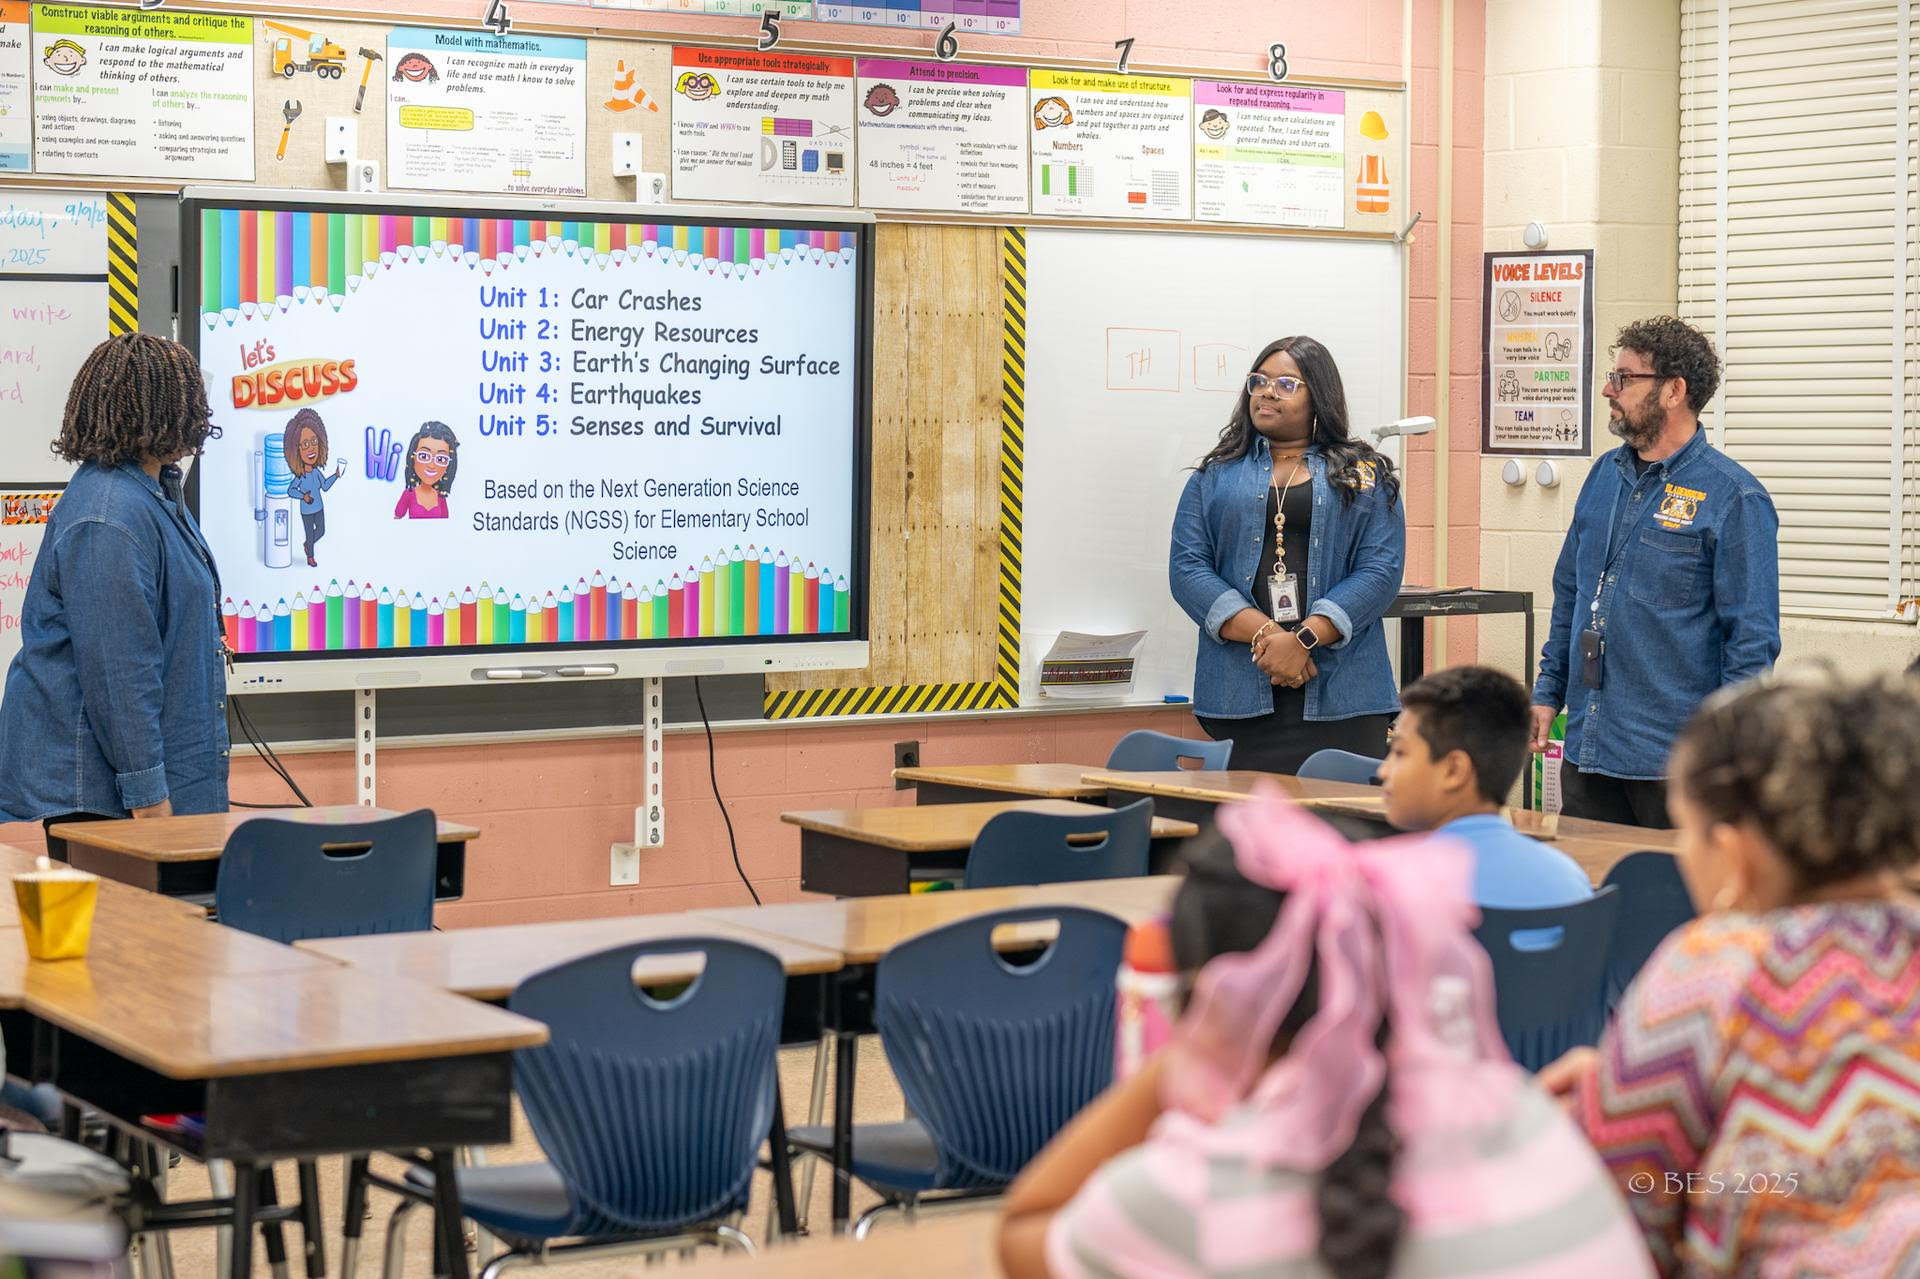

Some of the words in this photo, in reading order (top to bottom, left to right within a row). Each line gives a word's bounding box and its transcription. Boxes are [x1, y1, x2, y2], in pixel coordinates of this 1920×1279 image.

[41, 5, 88, 19] Construct
[91, 10, 118, 21] viable
[121, 14, 171, 24] arguments
[173, 15, 190, 25] and
[193, 16, 228, 28] critique
[231, 18, 245, 28] the
[484, 0, 511, 34] 4
[85, 24, 130, 37] reasoning
[132, 26, 142, 36] of
[144, 27, 176, 38] others.
[758, 10, 781, 49] 5
[435, 34, 462, 46] Model
[464, 36, 483, 47] with
[485, 38, 542, 52] mathematics.
[935, 21, 957, 60] 6
[100, 42, 103, 51] I
[122, 45, 146, 53] make
[148, 45, 178, 57] logical
[180, 49, 225, 58] arguments
[227, 50, 244, 58] and
[1114, 37, 1136, 73] 7
[100, 58, 136, 68] respond
[150, 60, 164, 68] the
[166, 61, 224, 71] mathematical
[446, 56, 450, 64] I
[452, 58, 465, 66] can
[467, 59, 506, 69] recognize
[508, 60, 528, 70] math
[530, 61, 537, 70] in
[540, 64, 574, 75] everyday
[698, 53, 712, 63] Use
[714, 55, 760, 67] appropriate
[763, 58, 781, 68] tools
[783, 58, 831, 72] strategically.
[1268, 43, 1288, 81] 8
[100, 70, 136, 83] thinking
[138, 72, 148, 81] of
[150, 73, 180, 83] others.
[909, 66, 936, 77] Attend
[937, 68, 945, 78] to
[946, 69, 980, 80] precision.
[446, 84, 486, 94] problems.
[760, 77, 785, 86] certain
[787, 79, 805, 88] tools
[807, 80, 815, 88] to
[816, 81, 832, 90] help
[1052, 75, 1069, 84] Look
[1070, 76, 1081, 85] for
[1083, 77, 1096, 86] and
[1098, 78, 1116, 88] make
[1130, 80, 1138, 89] of
[1139, 81, 1172, 91] structure.
[1217, 84, 1232, 93] Look
[1234, 85, 1244, 94] for
[1246, 86, 1258, 95] and
[1259, 89, 1284, 98] express
[1285, 90, 1316, 100] regularity
[1318, 91, 1324, 100] in
[726, 88, 753, 97] explore
[755, 89, 769, 98] and
[771, 90, 797, 100] deepen
[799, 93, 809, 102] my
[811, 93, 830, 101] math
[908, 85, 912, 93] I
[926, 86, 934, 95] be
[936, 88, 960, 97] precise
[962, 89, 980, 97] when
[982, 89, 1006, 100] solving
[726, 101, 780, 113] understanding.
[908, 98, 940, 108] problems
[942, 99, 955, 108] and
[956, 99, 973, 108] clear
[974, 101, 992, 109] when
[1229, 98, 1258, 107] repeated
[1259, 100, 1291, 110] reasoning.
[908, 110, 959, 122] communicating
[961, 113, 971, 122] my
[972, 113, 992, 122] ideas.
[1052, 141, 1083, 151] Numbers
[1142, 145, 1165, 156] Spaces
[870, 160, 879, 168] 48
[880, 160, 905, 169] inches
[919, 162, 933, 171] feet
[1494, 264, 1530, 281] VOICE
[1534, 262, 1583, 280] LEVELS
[480, 286, 527, 308] Unit
[538, 287, 558, 308] 1:
[571, 288, 608, 310] Car
[618, 289, 702, 312] Crashes
[1530, 291, 1562, 302] SILENCE
[13, 303, 72, 326] write
[480, 318, 527, 340] Unit
[537, 319, 558, 340] 2:
[571, 318, 645, 348] Energy
[654, 321, 758, 344] Resources
[240, 338, 276, 370] let's
[482, 350, 528, 372] Unit
[539, 350, 560, 372] 3:
[573, 350, 650, 373] Earth's
[660, 352, 750, 380] Changing
[760, 353, 841, 376] Surface
[1125, 347, 1152, 380] TH
[1216, 354, 1227, 377] H
[232, 358, 358, 409] DISCUSS
[1534, 371, 1570, 382] PARTNER
[479, 382, 526, 404] Unit
[536, 382, 558, 404] 4:
[570, 382, 702, 411] Earthquakes
[1515, 410, 1534, 421] TEAM
[479, 414, 526, 436] Unit
[536, 414, 558, 436] 5:
[570, 416, 644, 436] Senses
[654, 414, 690, 436] and
[700, 414, 781, 436] Survival
[365, 426, 403, 482] Hi
[484, 479, 538, 499] Based
[543, 483, 564, 498] on
[569, 479, 595, 498] the
[600, 478, 638, 498] Next
[644, 478, 732, 498] Generation
[737, 478, 800, 496] Science
[32, 503, 42, 518] to
[472, 511, 559, 531] Standards
[564, 510, 629, 535] (NGSS)
[634, 510, 656, 528] for
[661, 509, 751, 532] Elementary
[756, 507, 809, 527] School
[612, 540, 677, 560] Science
